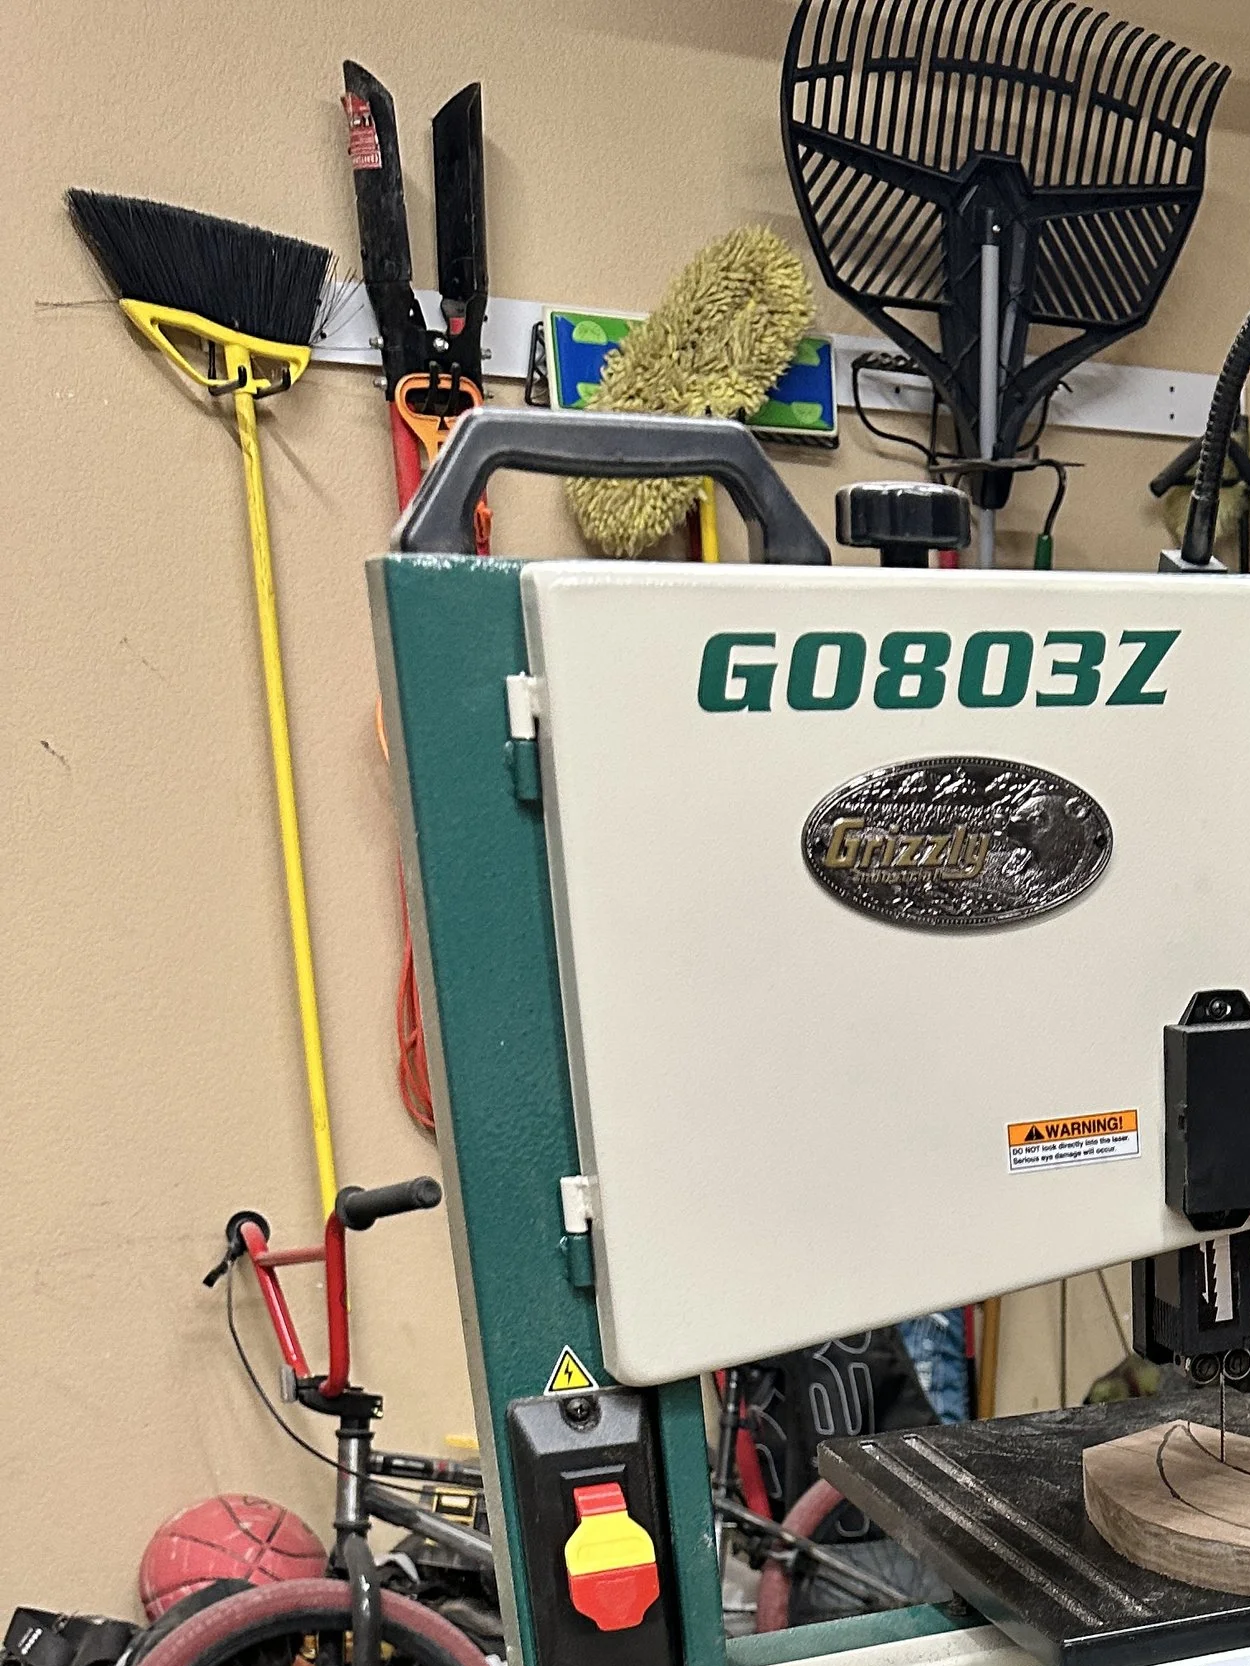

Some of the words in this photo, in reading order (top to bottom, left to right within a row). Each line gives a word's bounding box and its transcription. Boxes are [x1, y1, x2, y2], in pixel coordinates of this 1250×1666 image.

[696, 629, 1182, 714] G0803Z
[823, 816, 991, 879] Grizzly
[1045, 1116, 1123, 1139] WARNING!
[1059, 1140, 1083, 1150] directly
[1013, 1156, 1039, 1164] Serious
[1055, 1150, 1081, 1160] damage
